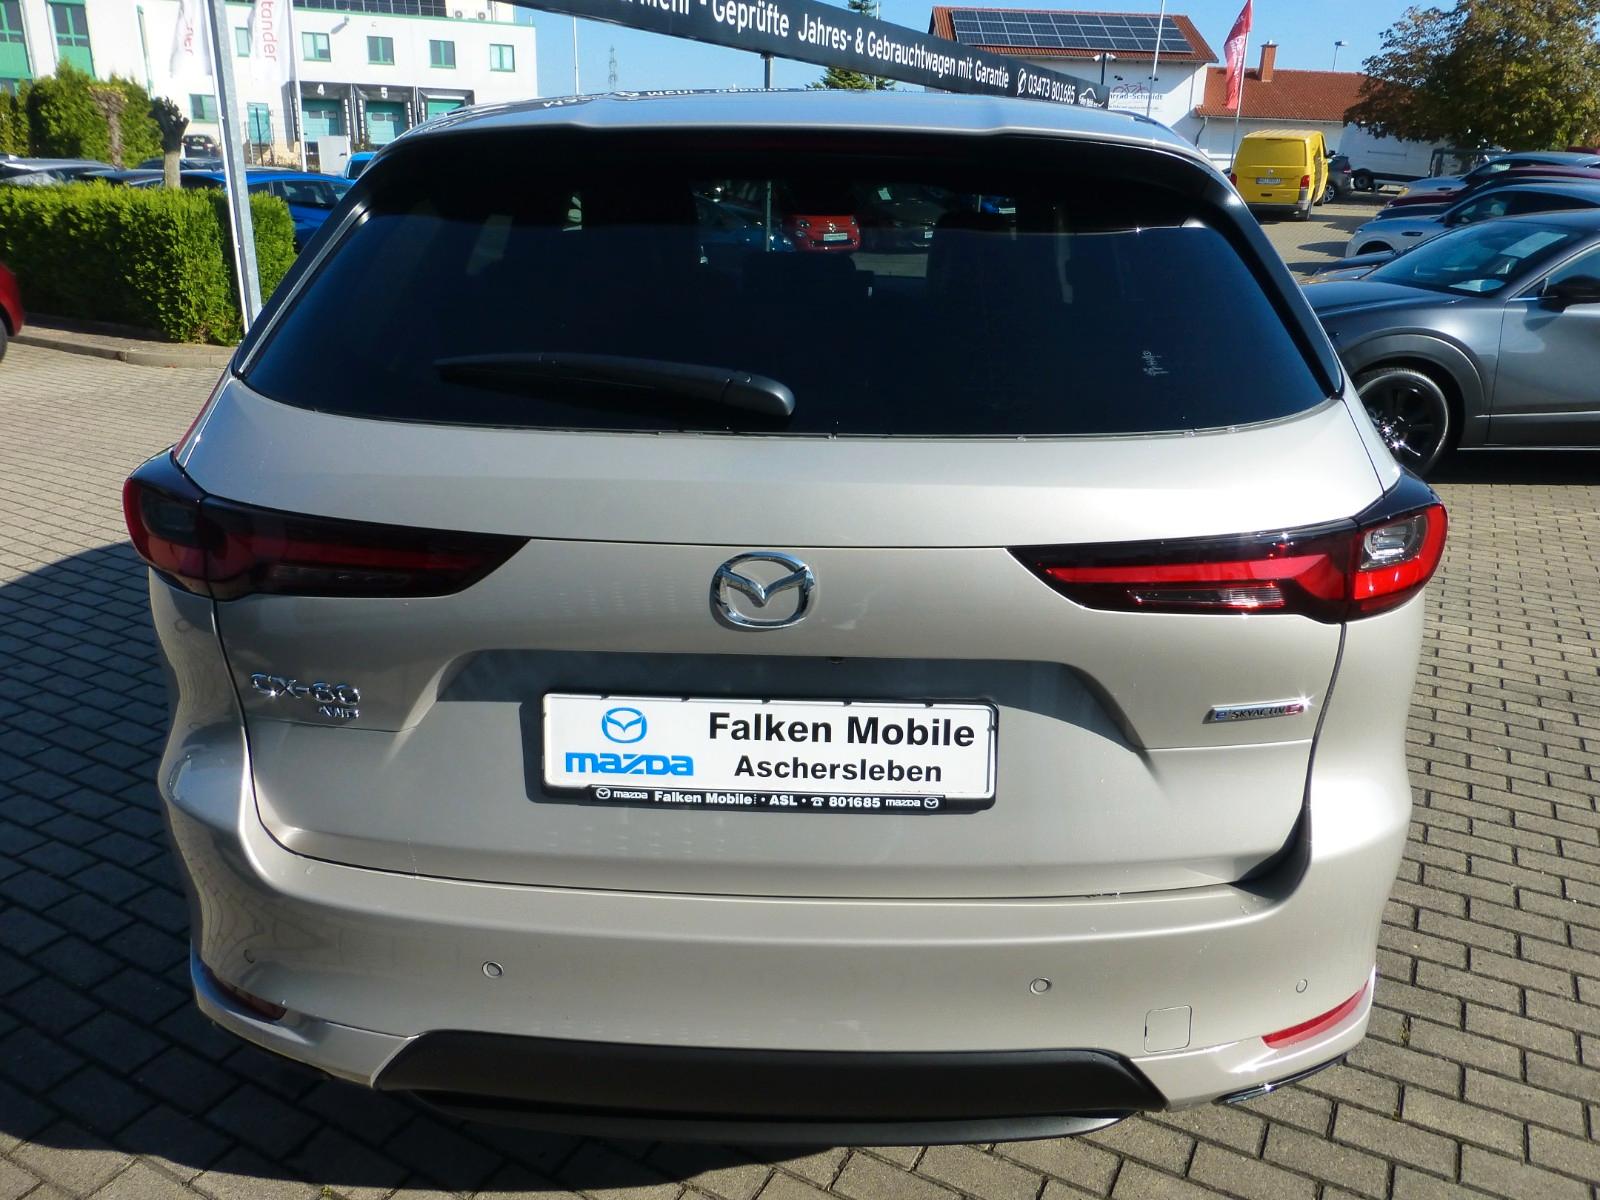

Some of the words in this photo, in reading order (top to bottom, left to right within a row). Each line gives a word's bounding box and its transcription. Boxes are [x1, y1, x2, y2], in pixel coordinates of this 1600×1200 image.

[712, 0, 790, 38] Geprüfte
[798, 13, 852, 51] Jahres-
[855, 27, 864, 55] &
[867, 31, 956, 79] Gebrauchtwagen
[957, 56, 973, 80] mit
[975, 60, 1009, 89] Garantie
[1027, 74, 1051, 98] 03473
[1051, 81, 1076, 105] 801685
[317, 83, 325, 96] 4
[380, 86, 388, 99] 5
[251, 672, 361, 705] CX-60
[708, 712, 833, 744] Falken
[846, 716, 976, 747] Mobile
[565, 752, 694, 777] mazda
[734, 754, 942, 782] Aschersleben
[654, 790, 701, 804] Falken
[769, 795, 798, 806] ASL
[828, 796, 880, 809] 801685
